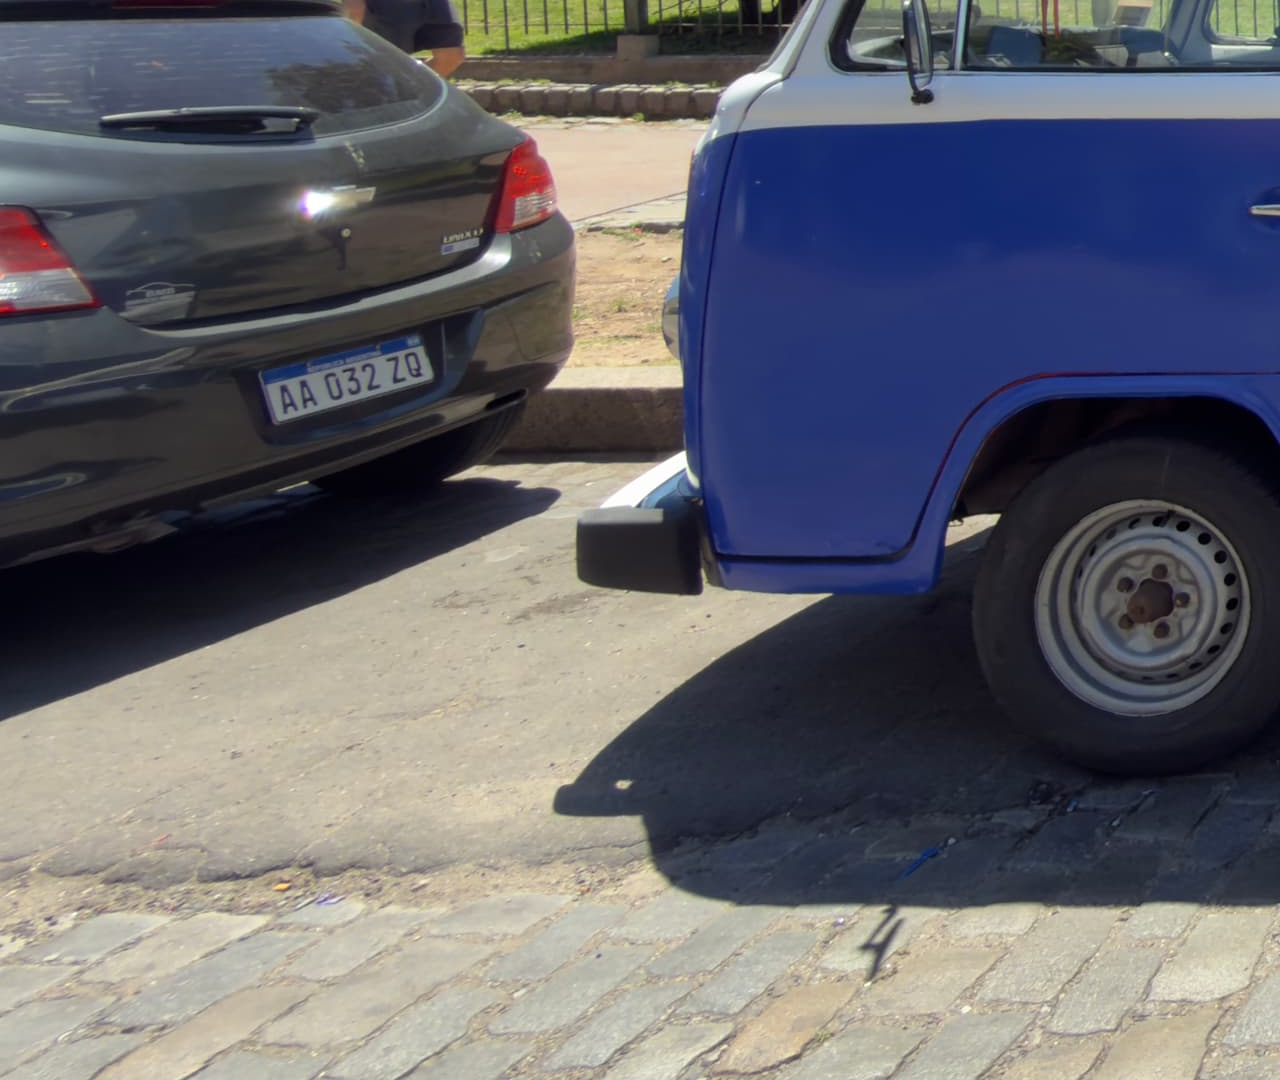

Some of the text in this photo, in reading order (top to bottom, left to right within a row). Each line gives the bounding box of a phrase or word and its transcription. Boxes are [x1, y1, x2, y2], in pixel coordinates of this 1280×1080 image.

[280, 379, 318, 414] AA
[323, 363, 381, 401] 032
[386, 351, 424, 384] ZQ
